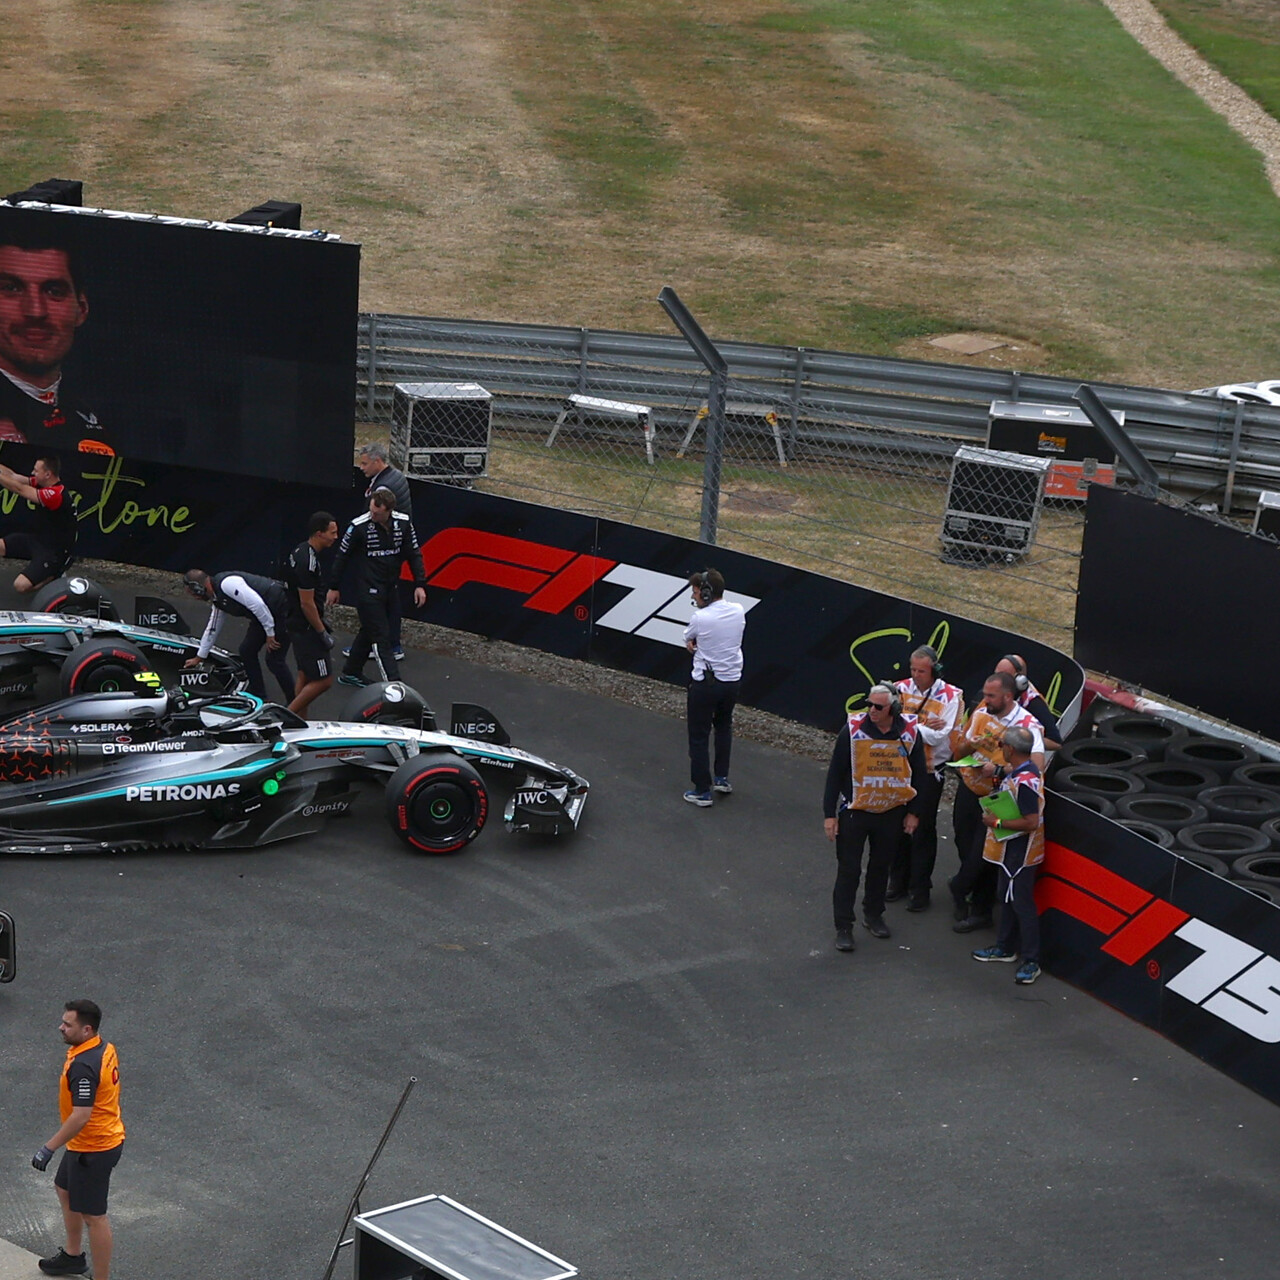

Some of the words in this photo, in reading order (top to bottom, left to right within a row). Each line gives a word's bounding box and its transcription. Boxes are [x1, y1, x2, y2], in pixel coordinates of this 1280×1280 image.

[400, 527, 618, 614] F1
[139, 613, 177, 624] INEOS
[152, 643, 186, 655] Einhell
[180, 672, 209, 687] IWC
[80, 723, 125, 733] SOLERA
[454, 722, 496, 735] INEOS
[117, 741, 186, 753] TeamViewer
[479, 757, 515, 770] Einhell
[126, 782, 241, 802] PETRONAS
[517, 791, 548, 805] IWC
[1164, 917, 1280, 1043] 75
